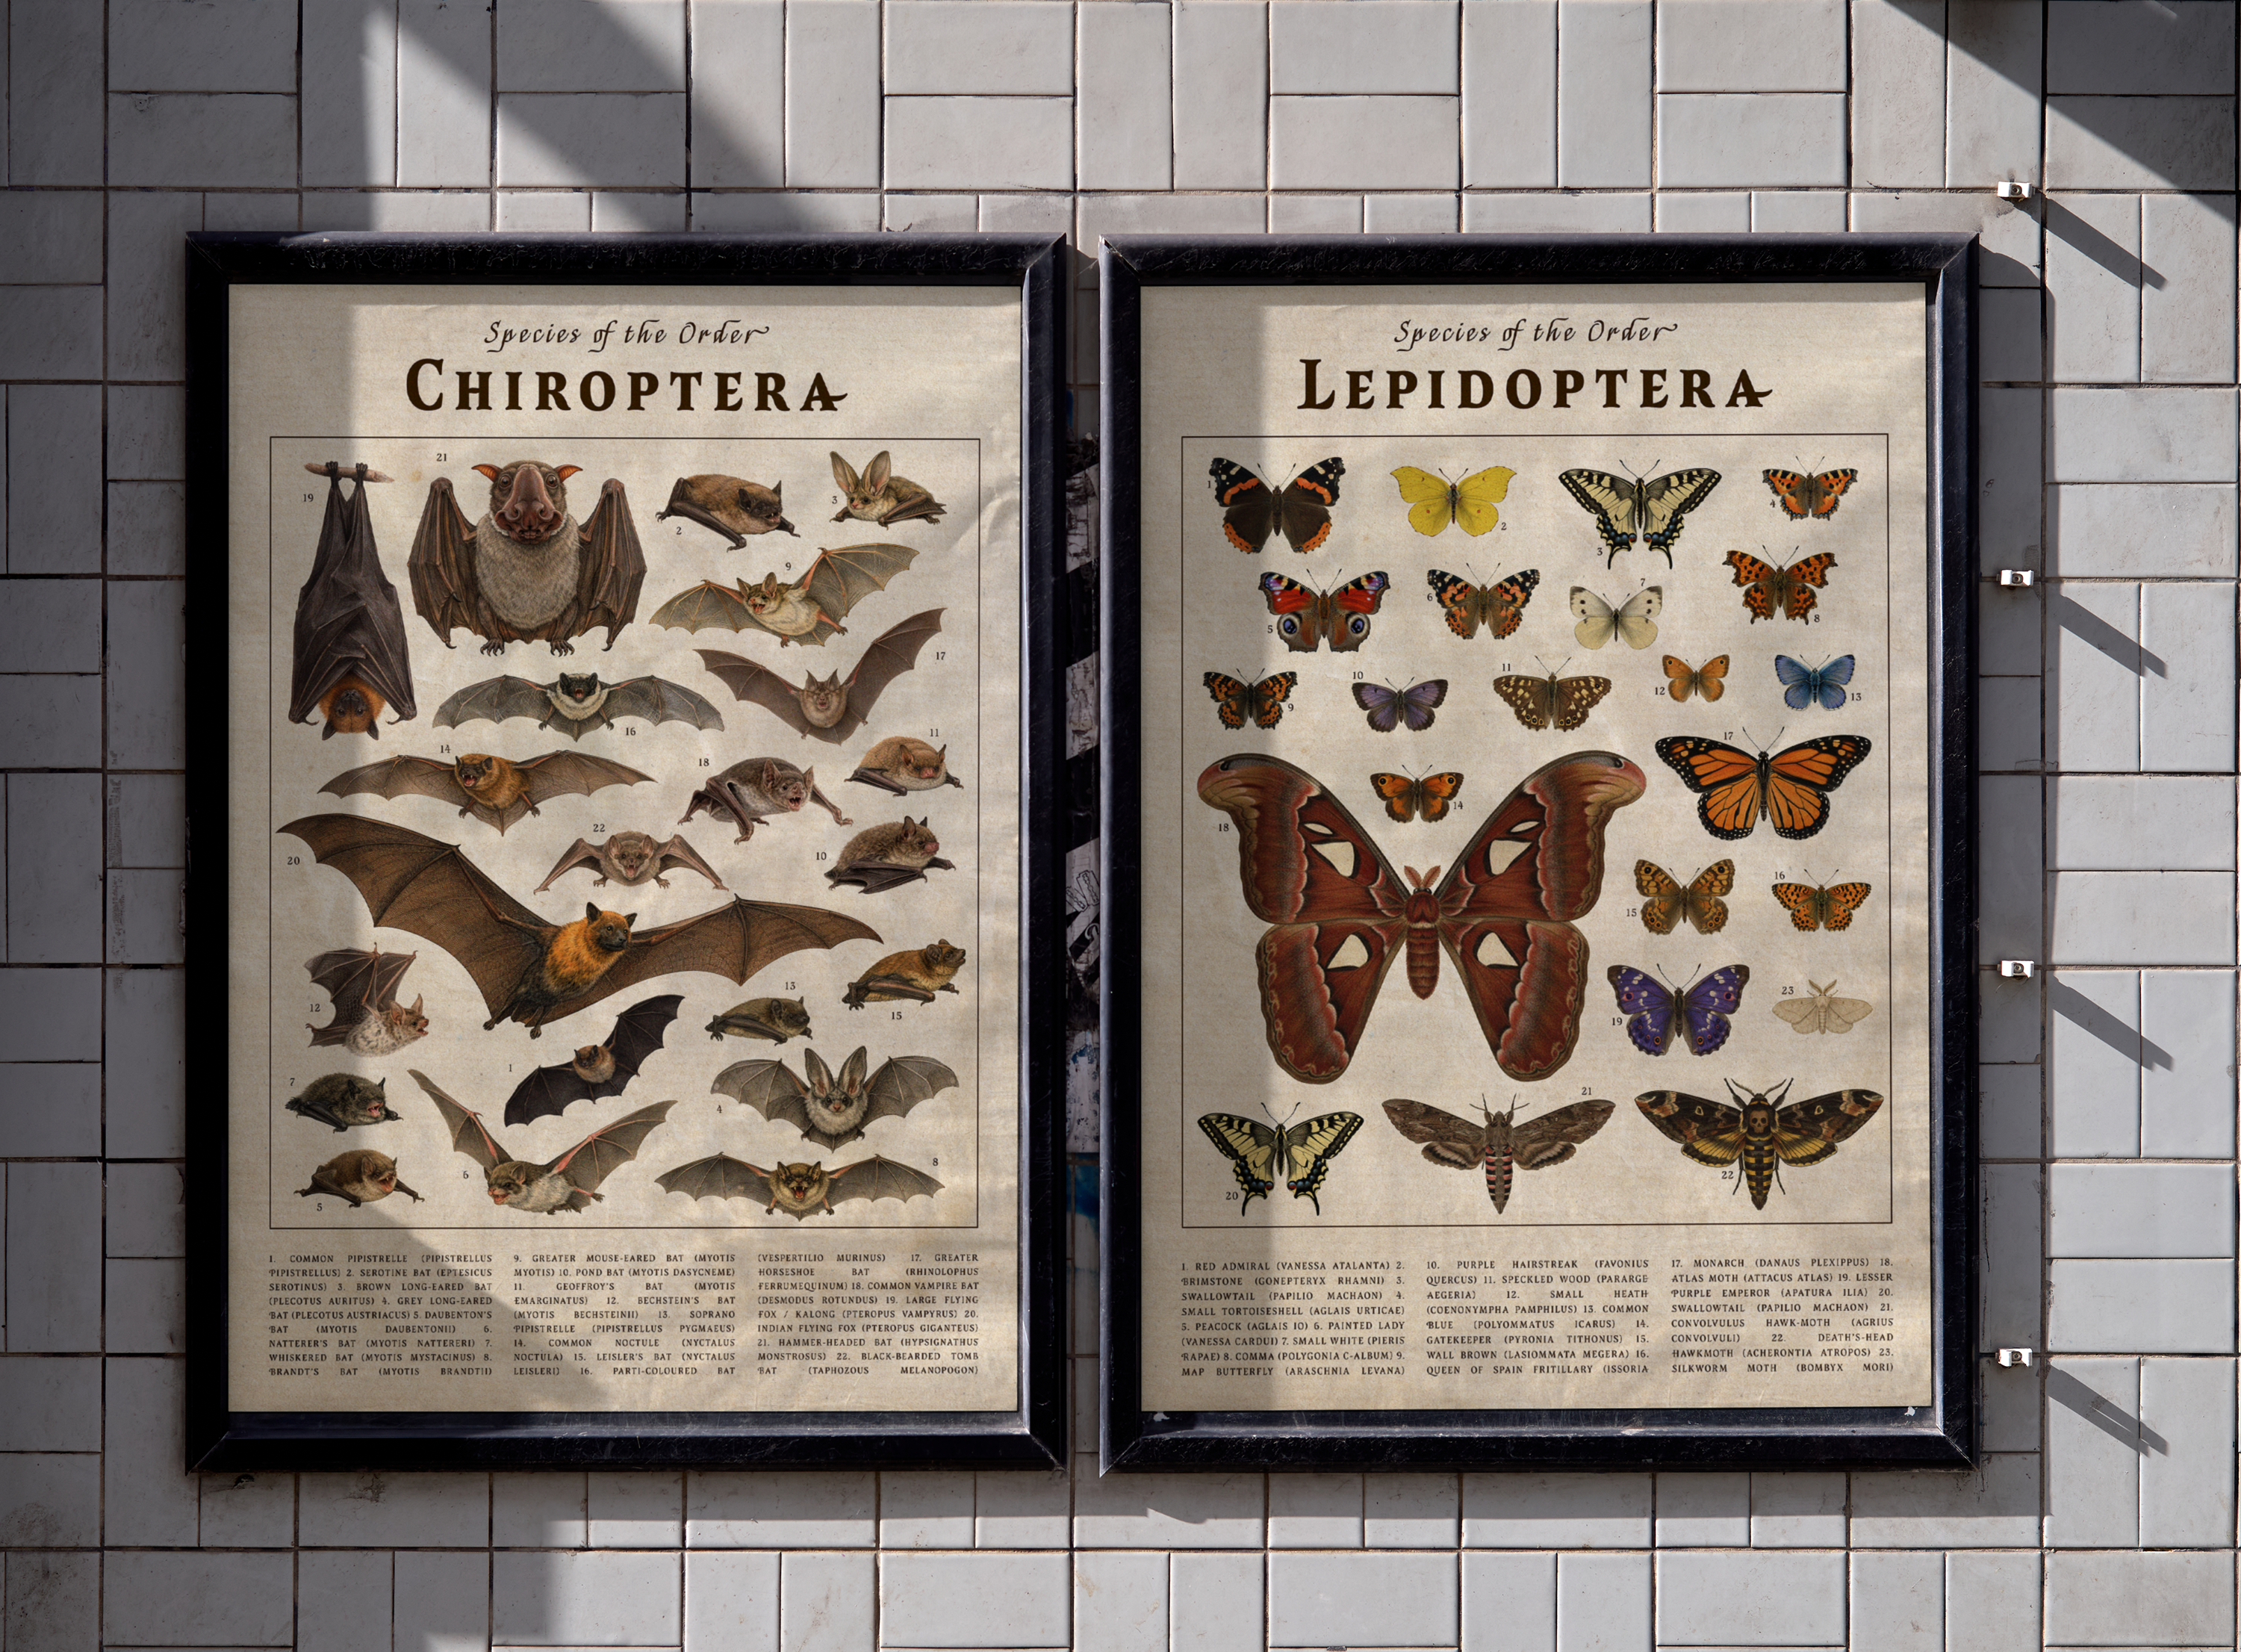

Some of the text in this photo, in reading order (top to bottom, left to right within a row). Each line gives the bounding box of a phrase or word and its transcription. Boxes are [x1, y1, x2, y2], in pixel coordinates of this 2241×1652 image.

[483, 320, 771, 353] Species of the Order
[1393, 317, 1679, 352] Species of the Order
[436, 453, 447, 462] 21
[303, 493, 314, 503] 19
[831, 495, 838, 505] 3
[1769, 499, 1776, 509] 4
[676, 526, 683, 535] 2
[1500, 521, 1507, 531] 2
[1597, 547, 1603, 556] 3
[785, 562, 792, 571] 9
[1640, 577, 1646, 587] 7
[1813, 614, 1821, 623] 8
[1267, 624, 1274, 634] 5
[936, 651, 946, 661] 17
[1502, 662, 1511, 672] 11
[1352, 671, 1364, 680] 10
[1655, 686, 1665, 696] 12
[1851, 692, 1862, 701] 13
[625, 727, 636, 736] 16
[440, 744, 451, 754] 14
[698, 757, 710, 767] 18
[593, 823, 606, 833] 22
[1218, 823, 1230, 832] 18
[287, 856, 301, 866] 20
[815, 851, 827, 861] 10
[1774, 871, 1785, 880] 16
[785, 981, 796, 990] 13
[1781, 986, 1794, 996] 23
[310, 1003, 321, 1013] 12
[1581, 1086, 1592, 1096] 21
[1225, 1191, 1239, 1201] 20
[269, 1254, 492, 1263] 1. COMMON PIPISTRELLE (PIPISTRELLUS
[513, 1254, 736, 1263] 9. GREATER MOUSE-EARED BAT (MYOTIS
[1181, 1261, 1405, 1271] 1. RED ADMIRAL (VANESSA ATALANTA) 2.
[1427, 1259, 1649, 1270] 10. PURPLE HAIRSTREAK (FAVONIUS
[758, 1267, 979, 1276] HORSESHOE BAT (RHINOLOPHUS
[1671, 1273, 1893, 1283] ATLAS MOTH (ATTACUS ATLAS) 19. LESSER
[269, 1282, 491, 1291] SEROTINUS) 3. BROWN LONG-EARED BAT
[514, 1282, 736, 1291] 11. GEOFFROY'S BAT (MYOTIS
[1181, 1291, 1405, 1301] SWALLOWTAIL (PAPILIO MACHAON) 4.
[1426, 1289, 1649, 1299] AEGERIA) 12. SMALL HEATH
[757, 1296, 979, 1305] (DESMODUS ROTUNDUS) 19. LARGE FLYING
[1671, 1302, 1893, 1313] SWALLOWTAIL (PAPILIO MACHAON) 21.
[268, 1311, 492, 1320] BAT (PLECOTUS AUSTRIACUS) 5. DAUBENTON'S
[514, 1310, 736, 1320] (MYOTIS BECHSTEINII) 13. SOPRANO
[757, 1323, 978, 1333] INDIAN FLYING FOX (PTEROPUS GIGANTEUS)
[1181, 1321, 1405, 1332] 5. PEACOCK (AGLAIS IO) 6. PAINTED LADY
[1426, 1319, 1649, 1329] BLUE (POLYOMMATUS ICARUS) 14.
[514, 1338, 736, 1347] 14. COMMON NOCTULE (NYCTALUS
[1670, 1332, 1894, 1343] CONVOLVULI) 22. DEATH'S-HEAD
[269, 1339, 492, 1348] NATTERER'S BAT (MYOTIS NATTERERI) 7.
[757, 1352, 979, 1361] MONSTROSUS) 22. BLACK-BEARDED TOMB
[1426, 1350, 1650, 1360] WALL BROWN (LASIOMMATA MEGERA) 16.
[1181, 1366, 1405, 1376] MAP BUTTERFLY (ARASCHNIA LEVANA)
[1671, 1363, 1894, 1373] SILKWORM MOTH (BOMBYX MORI)
